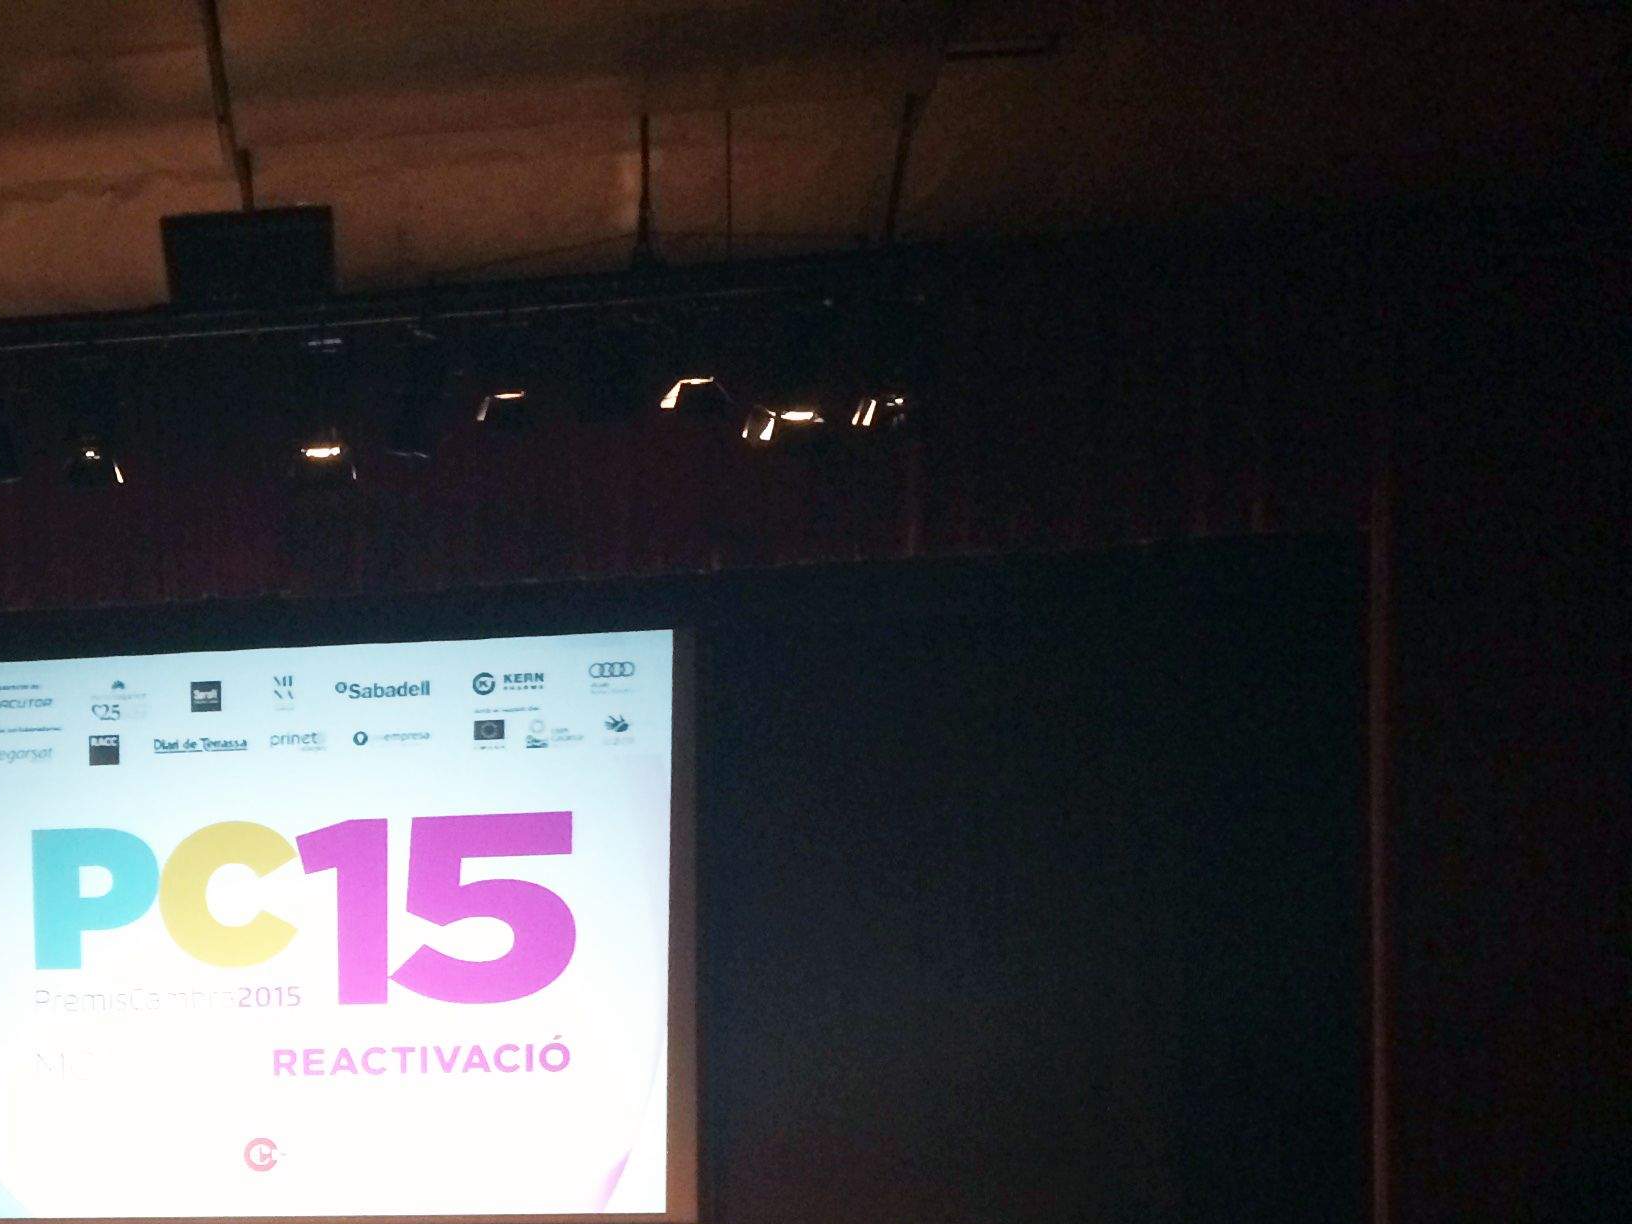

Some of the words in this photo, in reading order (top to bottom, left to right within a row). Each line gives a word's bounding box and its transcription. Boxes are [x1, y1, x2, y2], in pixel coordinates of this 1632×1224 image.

[503, 671, 545, 684] KERN
[348, 679, 432, 700] Sabadell
[182, 737, 198, 750] de
[30, 809, 578, 1006] PC15
[271, 1034, 573, 1077] REACTIVACIÓ
